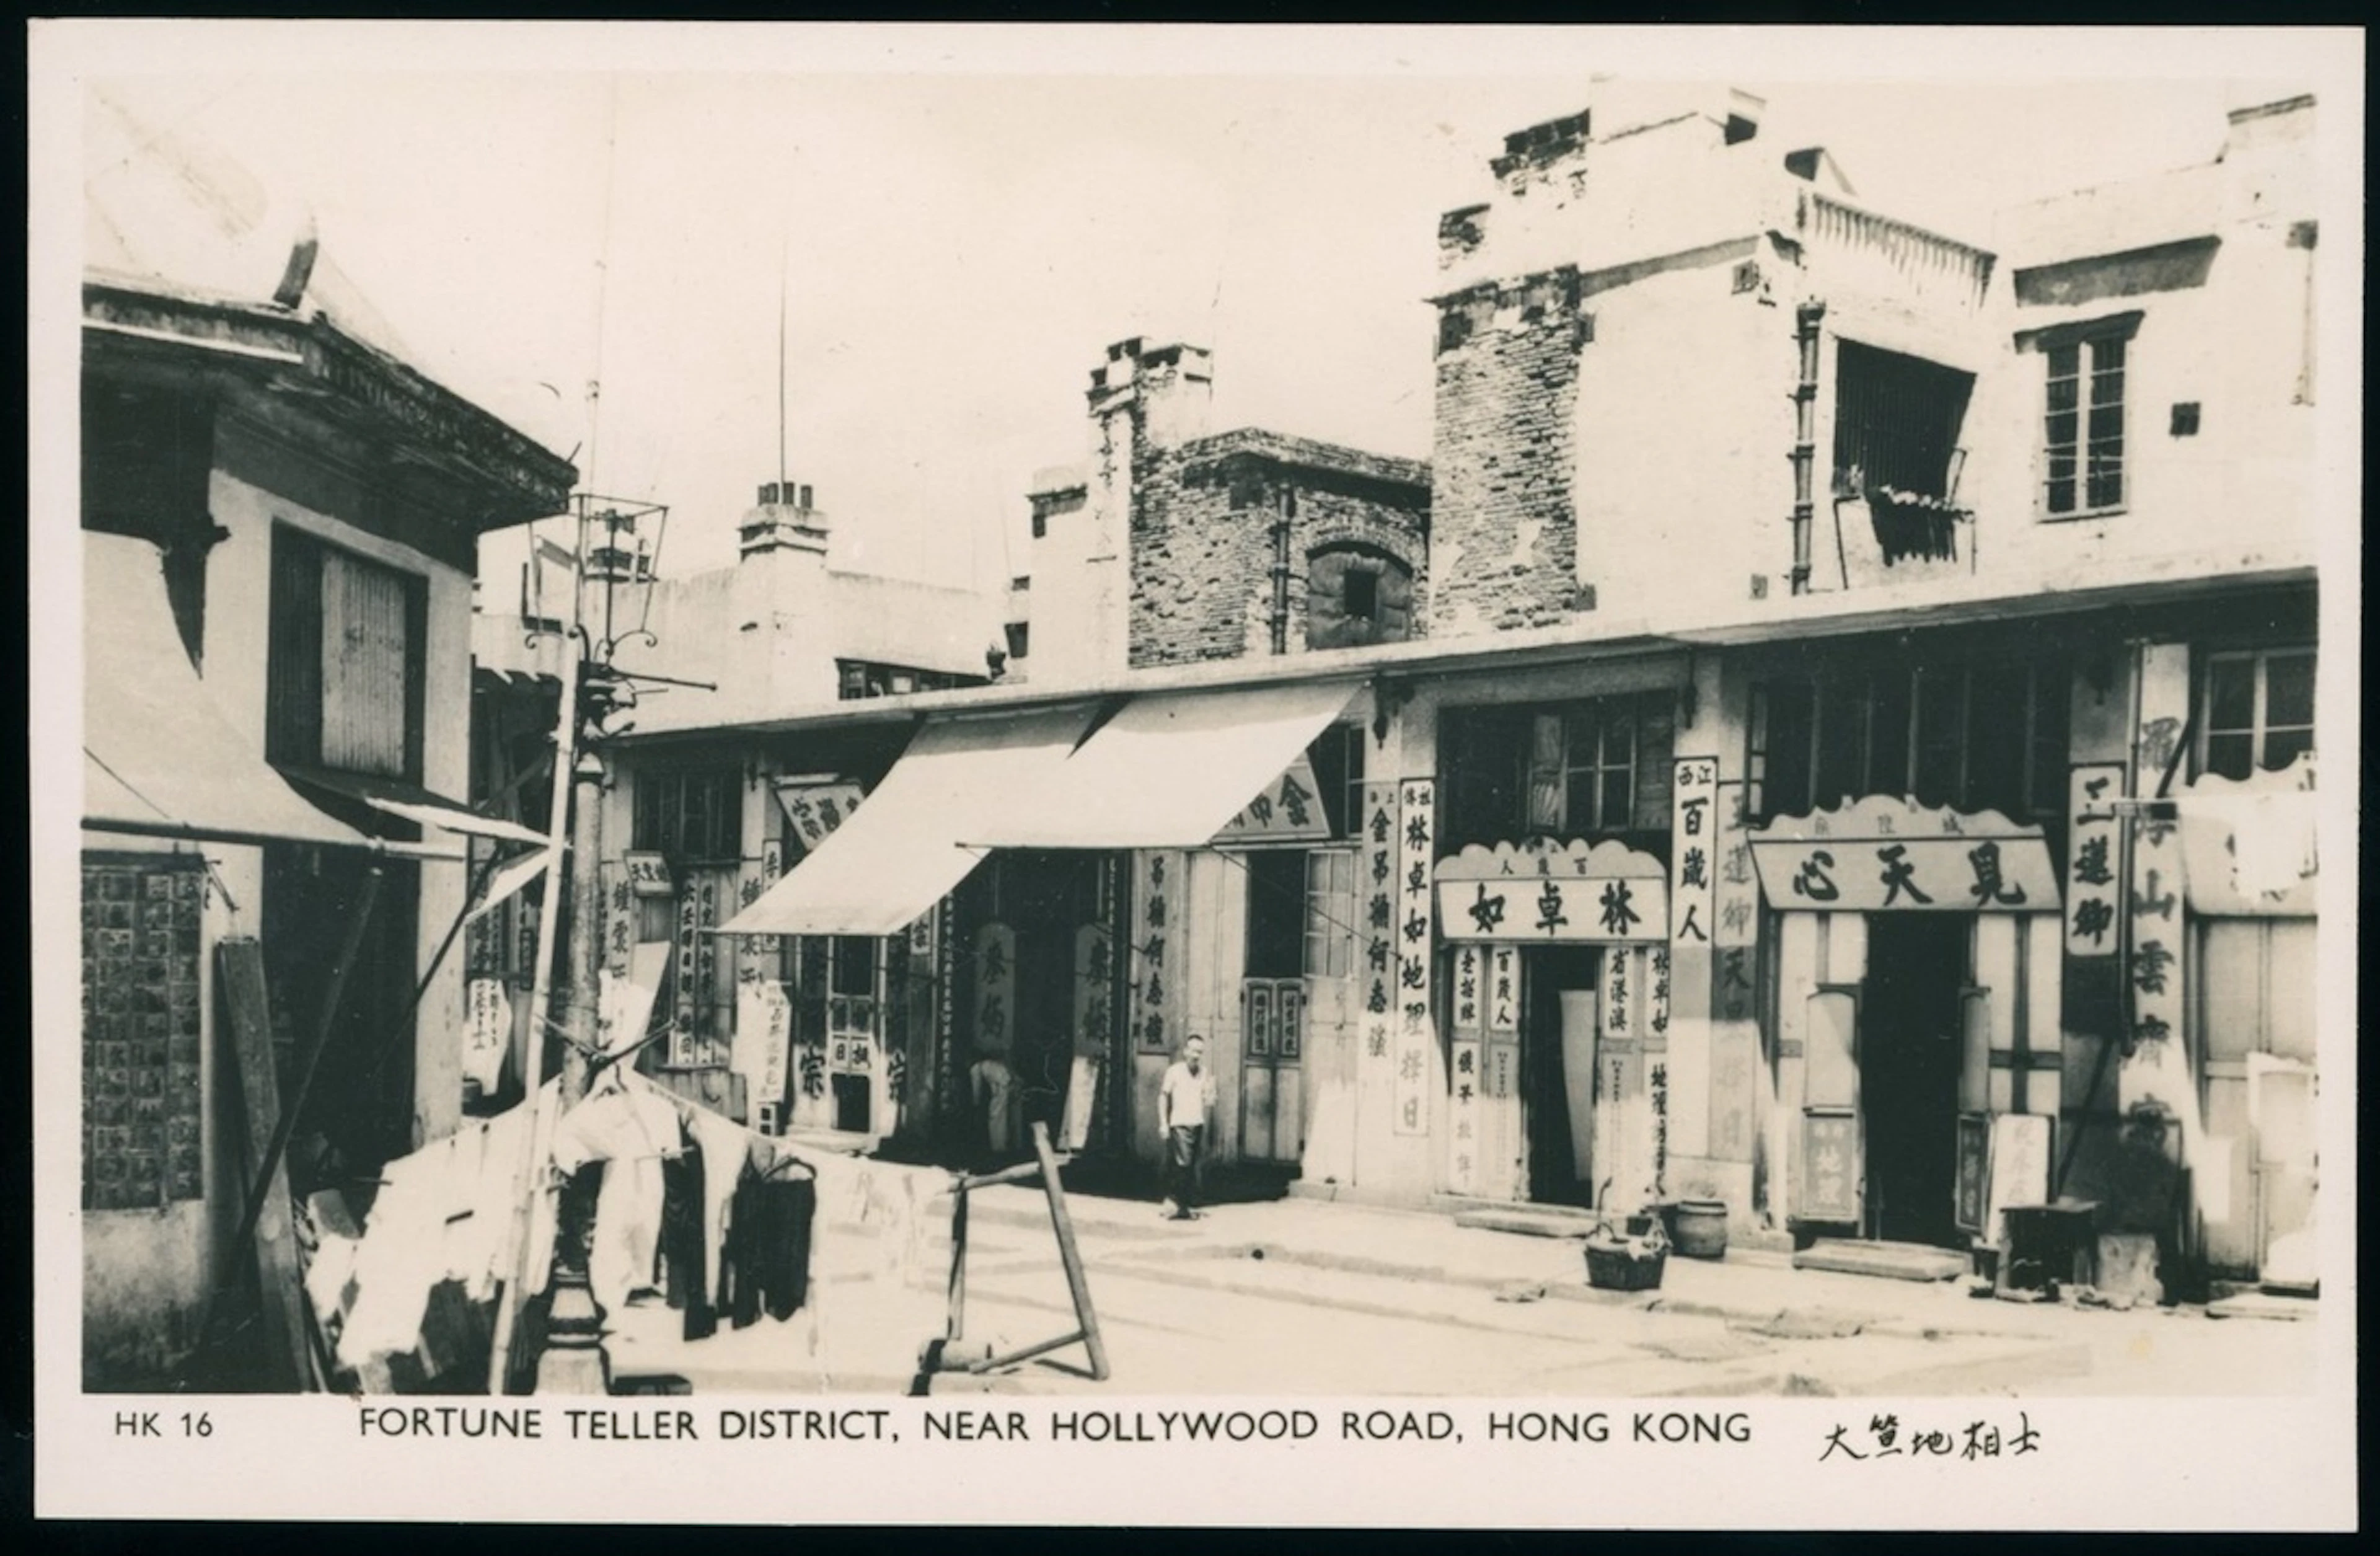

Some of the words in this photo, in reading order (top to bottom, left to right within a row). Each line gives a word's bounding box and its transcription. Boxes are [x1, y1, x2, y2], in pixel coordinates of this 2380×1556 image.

[1677, 795, 1711, 942] 百歲人
[1792, 841, 2027, 907] 見天心
[1468, 878, 1642, 936] 林卓如
